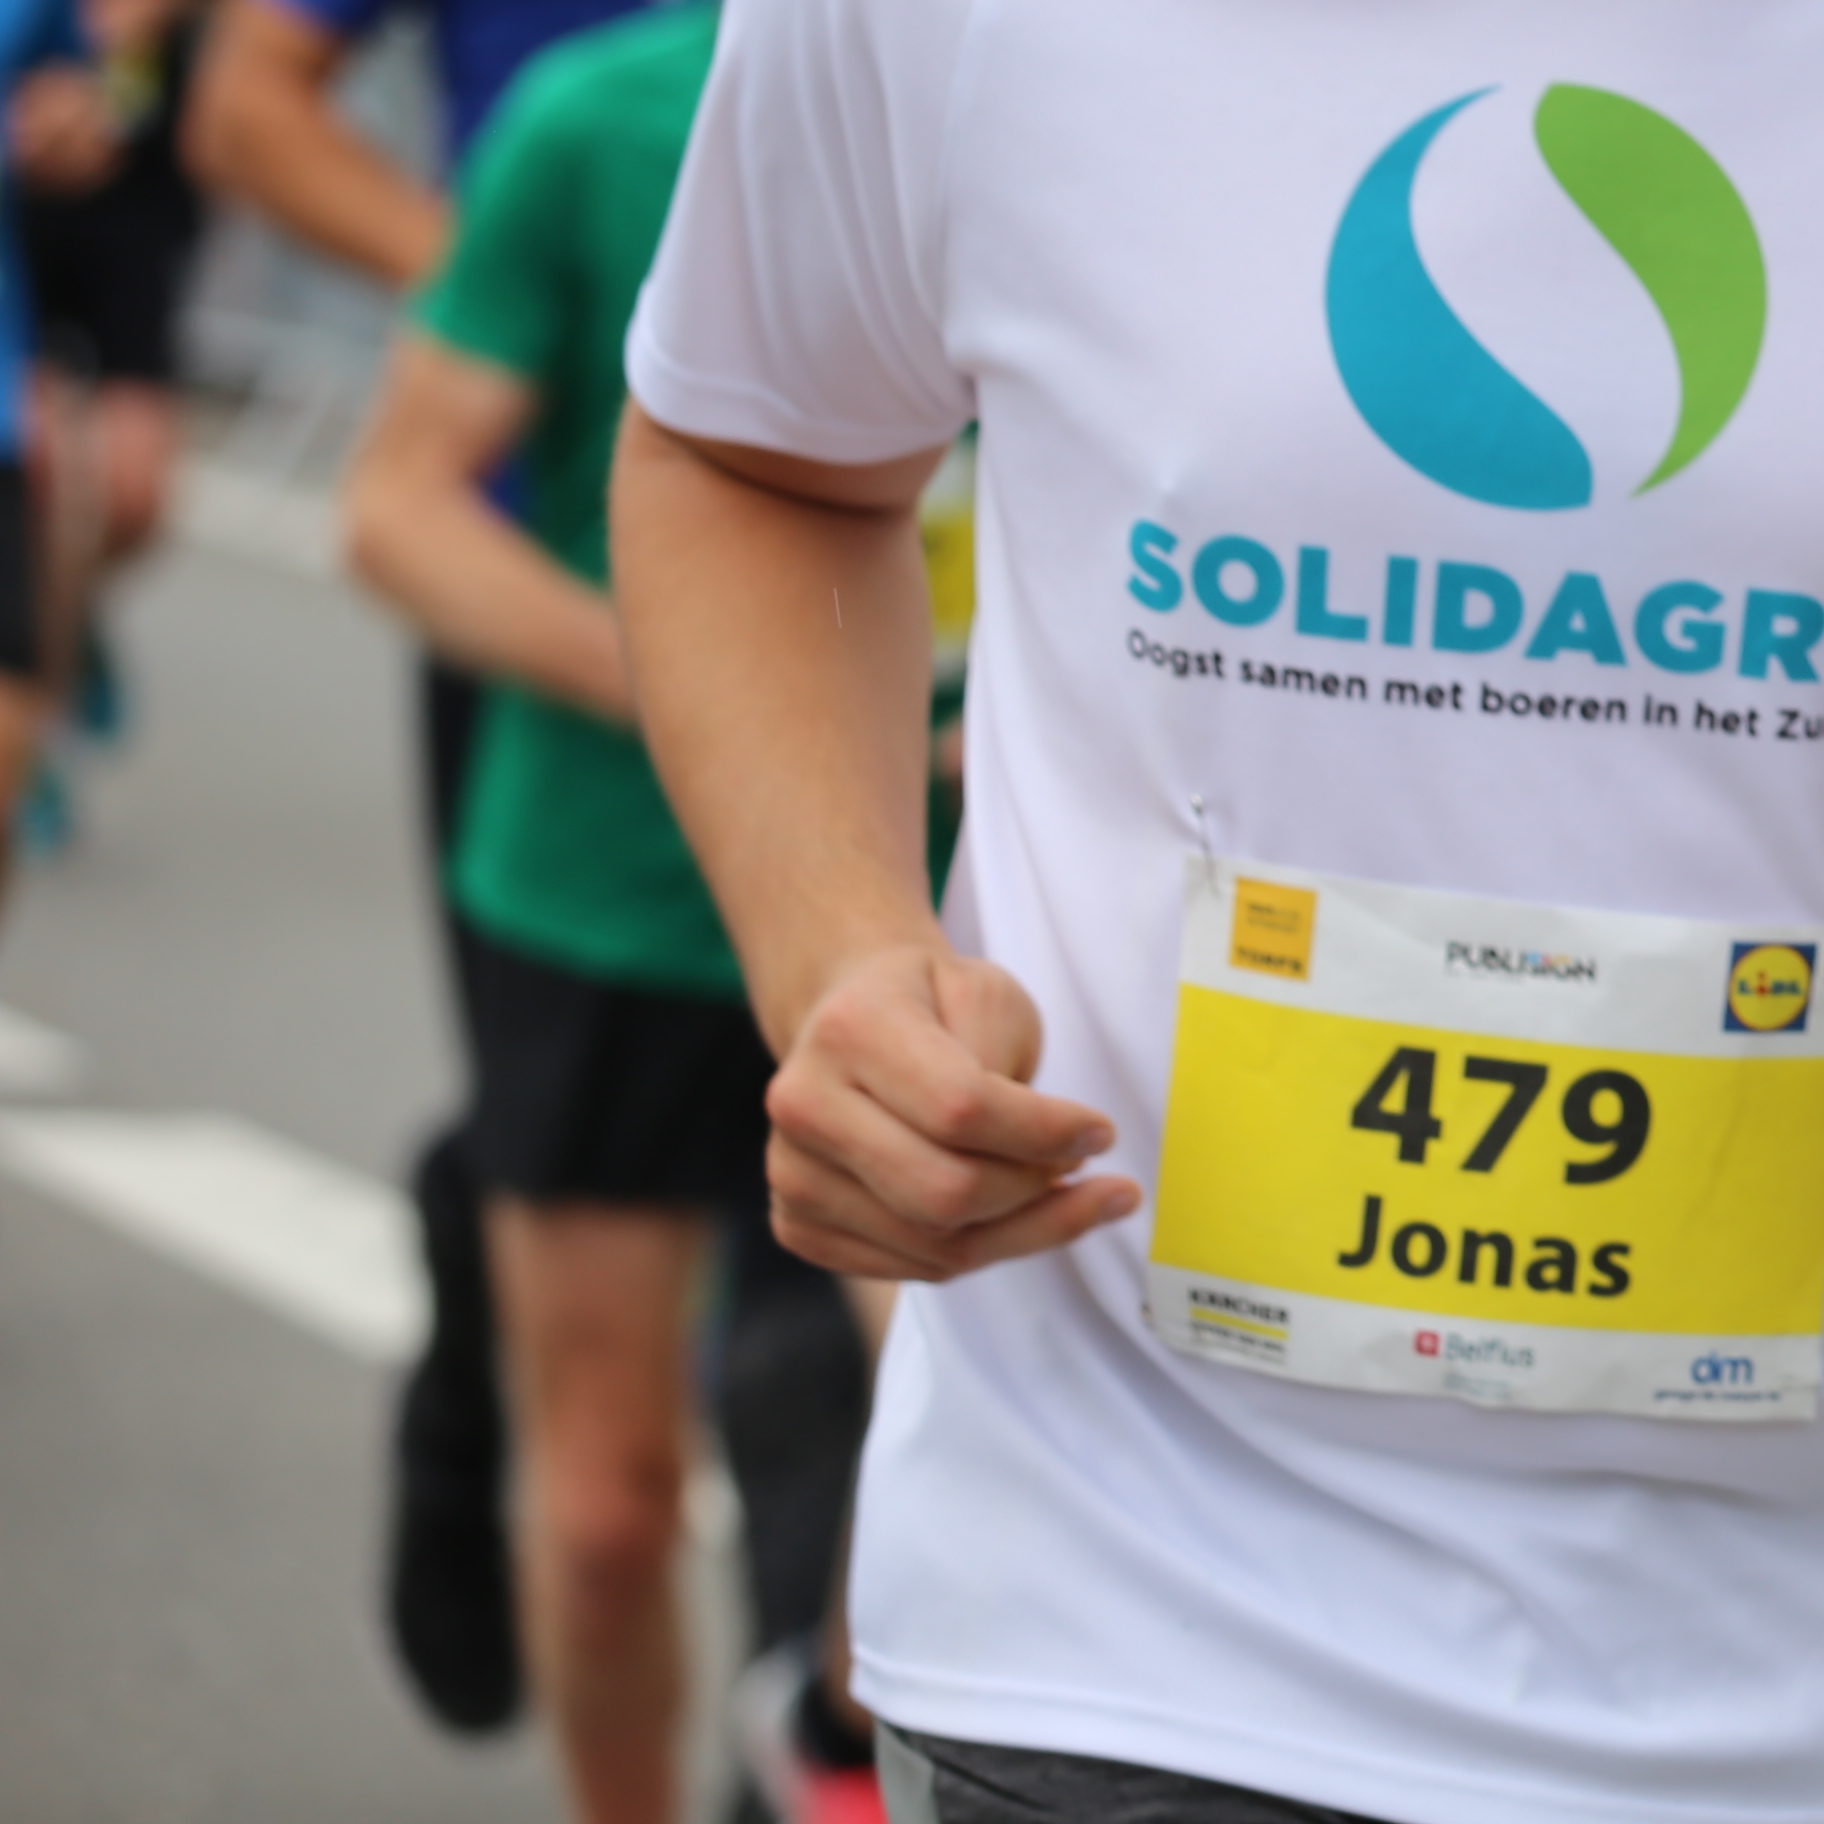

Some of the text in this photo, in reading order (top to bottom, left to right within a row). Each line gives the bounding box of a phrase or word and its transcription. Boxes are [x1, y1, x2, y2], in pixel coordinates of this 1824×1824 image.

[1127, 628, 1225, 679] Oogst
[1239, 658, 1378, 701] samen
[1383, 678, 1463, 711] met
[1480, 682, 1629, 725] boeren
[1642, 693, 1679, 727] in
[1694, 700, 1760, 738] het
[1349, 1045, 1652, 1186] 479
[1337, 1194, 1633, 1299] Jonas
[1445, 1332, 1536, 1368] Belfius
